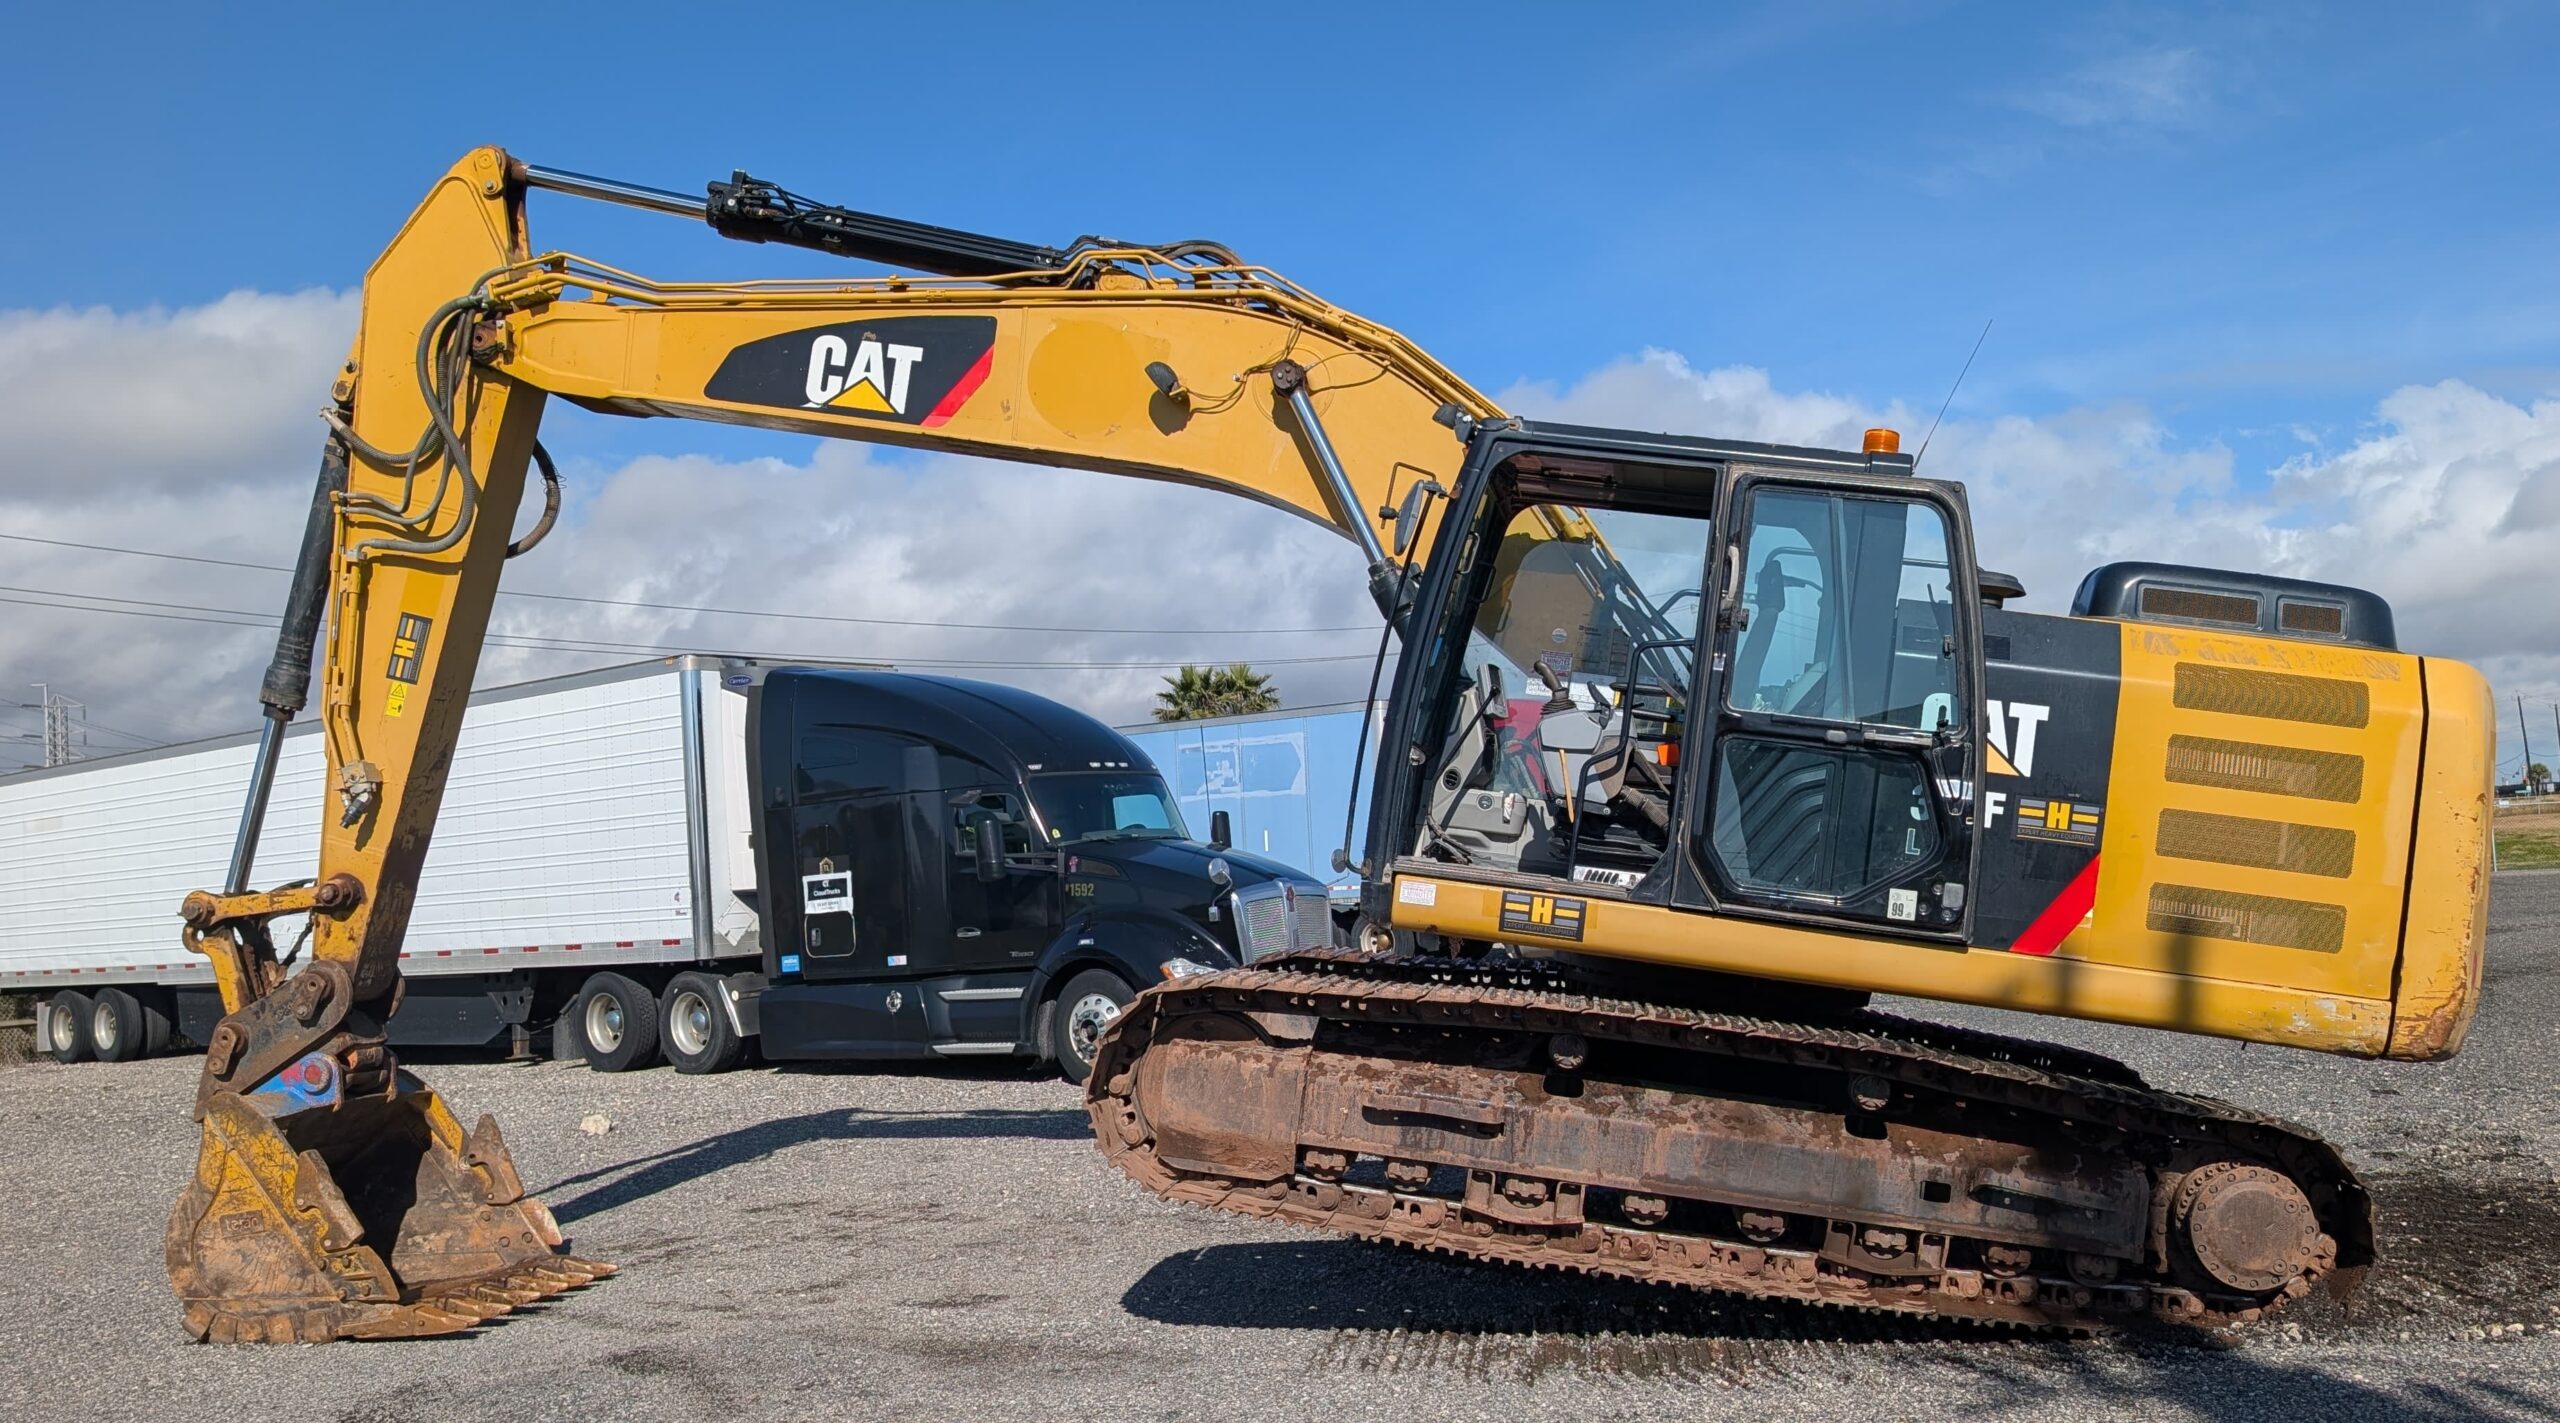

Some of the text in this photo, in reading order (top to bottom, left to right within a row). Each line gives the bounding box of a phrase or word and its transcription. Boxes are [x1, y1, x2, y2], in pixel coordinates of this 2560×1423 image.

[805, 334, 924, 415] CAT
[2017, 827, 2095, 843] EXPERT HEAVY EQUIPMENT
[1891, 902, 1904, 917] 99
[1503, 921, 1578, 937] EXPERT HEAVY EQUIPMENT
